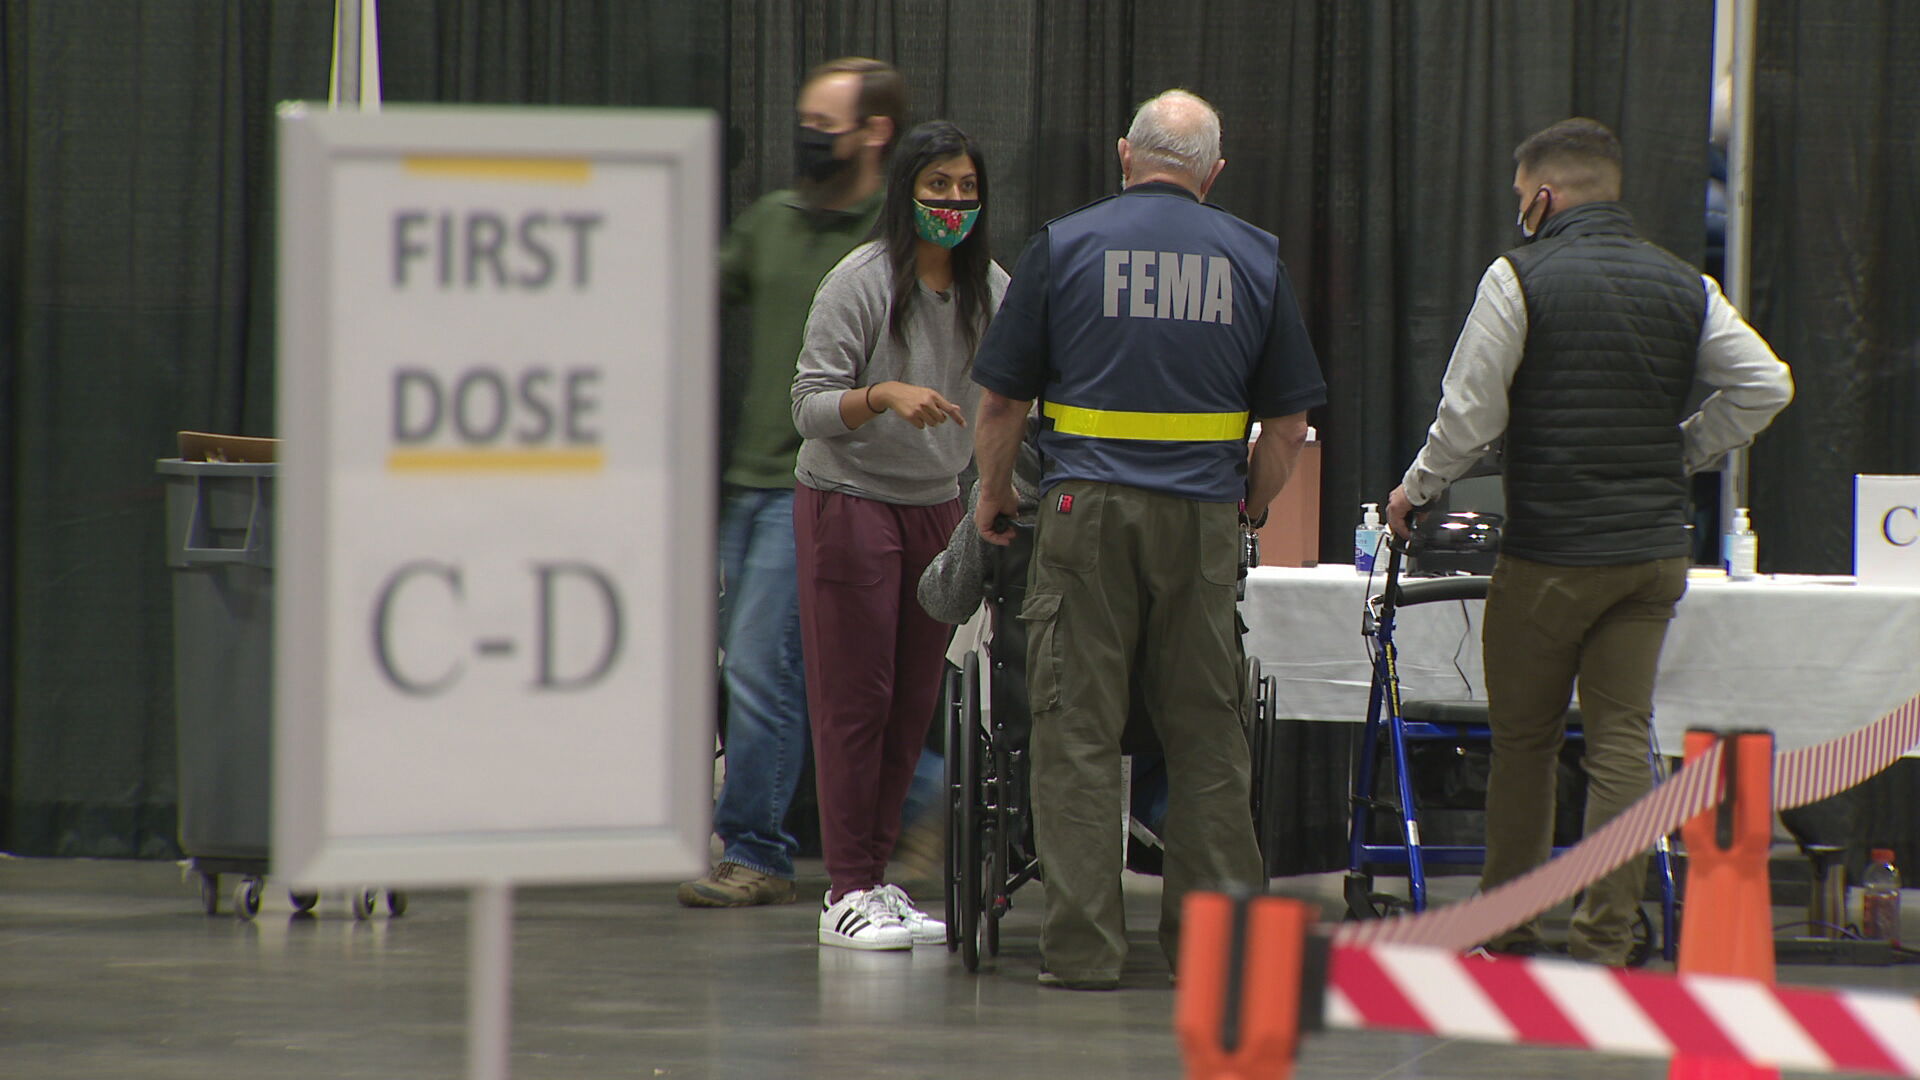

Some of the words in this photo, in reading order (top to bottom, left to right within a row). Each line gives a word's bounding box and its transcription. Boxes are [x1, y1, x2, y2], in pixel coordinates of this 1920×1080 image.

[392, 210, 604, 290] FIRST
[1103, 250, 1233, 325] FEMA
[390, 367, 605, 447] DOSE
[370, 560, 625, 699] C-D
